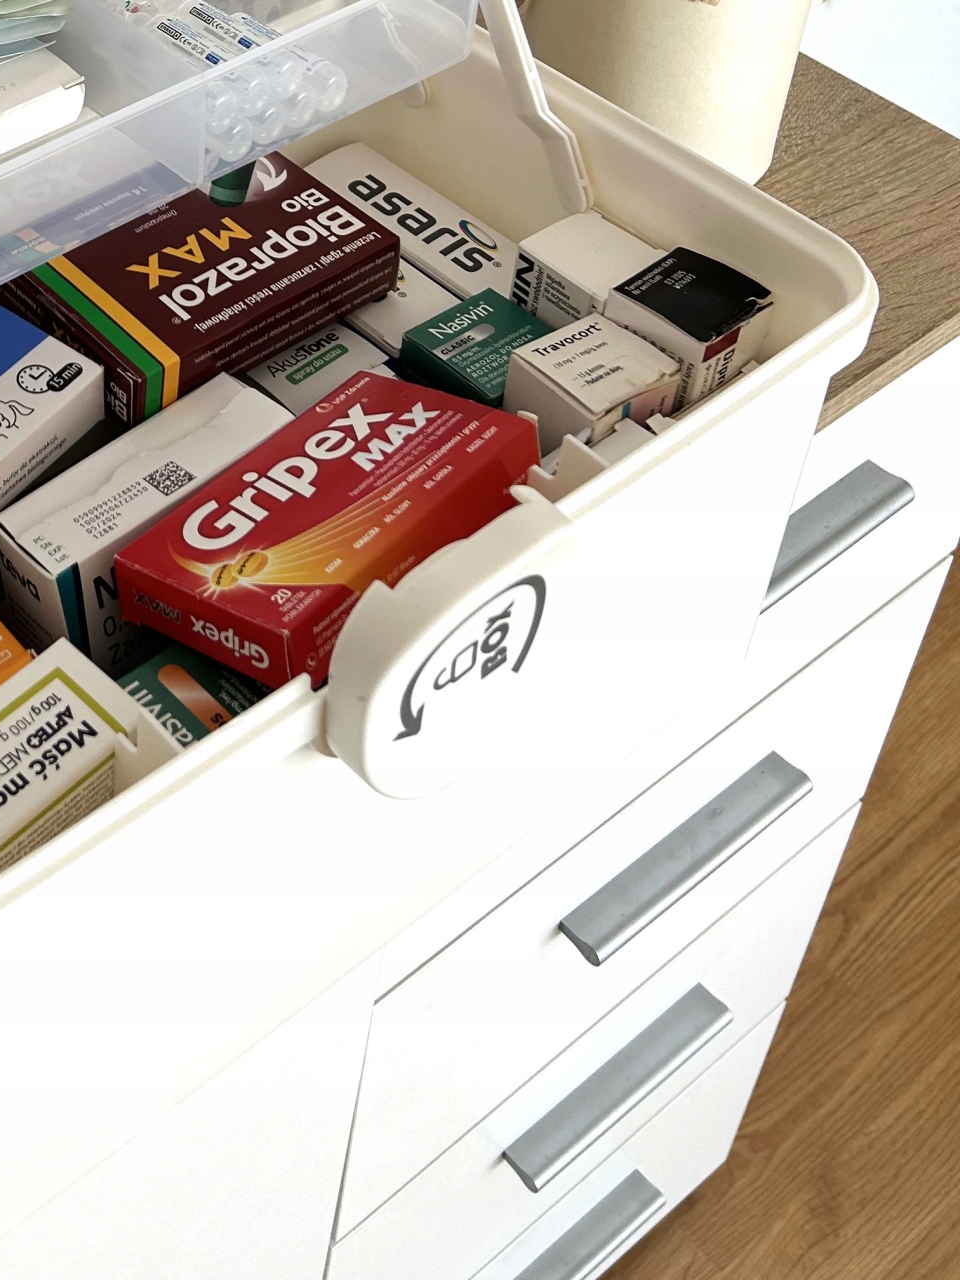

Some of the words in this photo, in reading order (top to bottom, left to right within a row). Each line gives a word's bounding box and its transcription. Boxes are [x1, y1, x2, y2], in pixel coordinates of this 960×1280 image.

[280, 188, 330, 213] Bio
[348, 174, 495, 272] asaris
[125, 216, 253, 290] MAX
[318, 246, 343, 267] zgagi
[342, 231, 381, 253] Leczenie
[158, 205, 365, 322] Bioprazol
[271, 262, 315, 292] zarzucania
[248, 286, 272, 305] treści
[427, 304, 494, 339] Nasivin
[266, 333, 339, 378] AkusTone
[440, 335, 475, 355] CLASSIC
[466, 353, 500, 373] AEROZOL
[499, 346, 512, 354] DO
[512, 334, 533, 347] NOSA
[532, 323, 602, 357] Travocort
[49, 377, 64, 389] 15
[63, 362, 81, 380] min
[293, 364, 315, 380] spray
[313, 359, 323, 368] do
[322, 348, 341, 361] uszu
[471, 355, 509, 378] ROZTWÓR
[110, 382, 127, 404] Bio
[350, 401, 441, 472] MAX
[181, 401, 394, 551] Gripex
[380, 476, 408, 502] Nasilone
[406, 462, 428, 483] objawy
[463, 420, 480, 439] grypy
[85, 511, 122, 534] 05/2024
[91, 522, 119, 540] 12881
[324, 557, 344, 574] KATAR
[133, 588, 182, 623] MAX
[271, 589, 293, 605] 20
[279, 590, 307, 612] TABLETEK
[189, 614, 269, 669] Gripex
[480, 599, 516, 680] BOX
[28, 719, 99, 781] Maść
